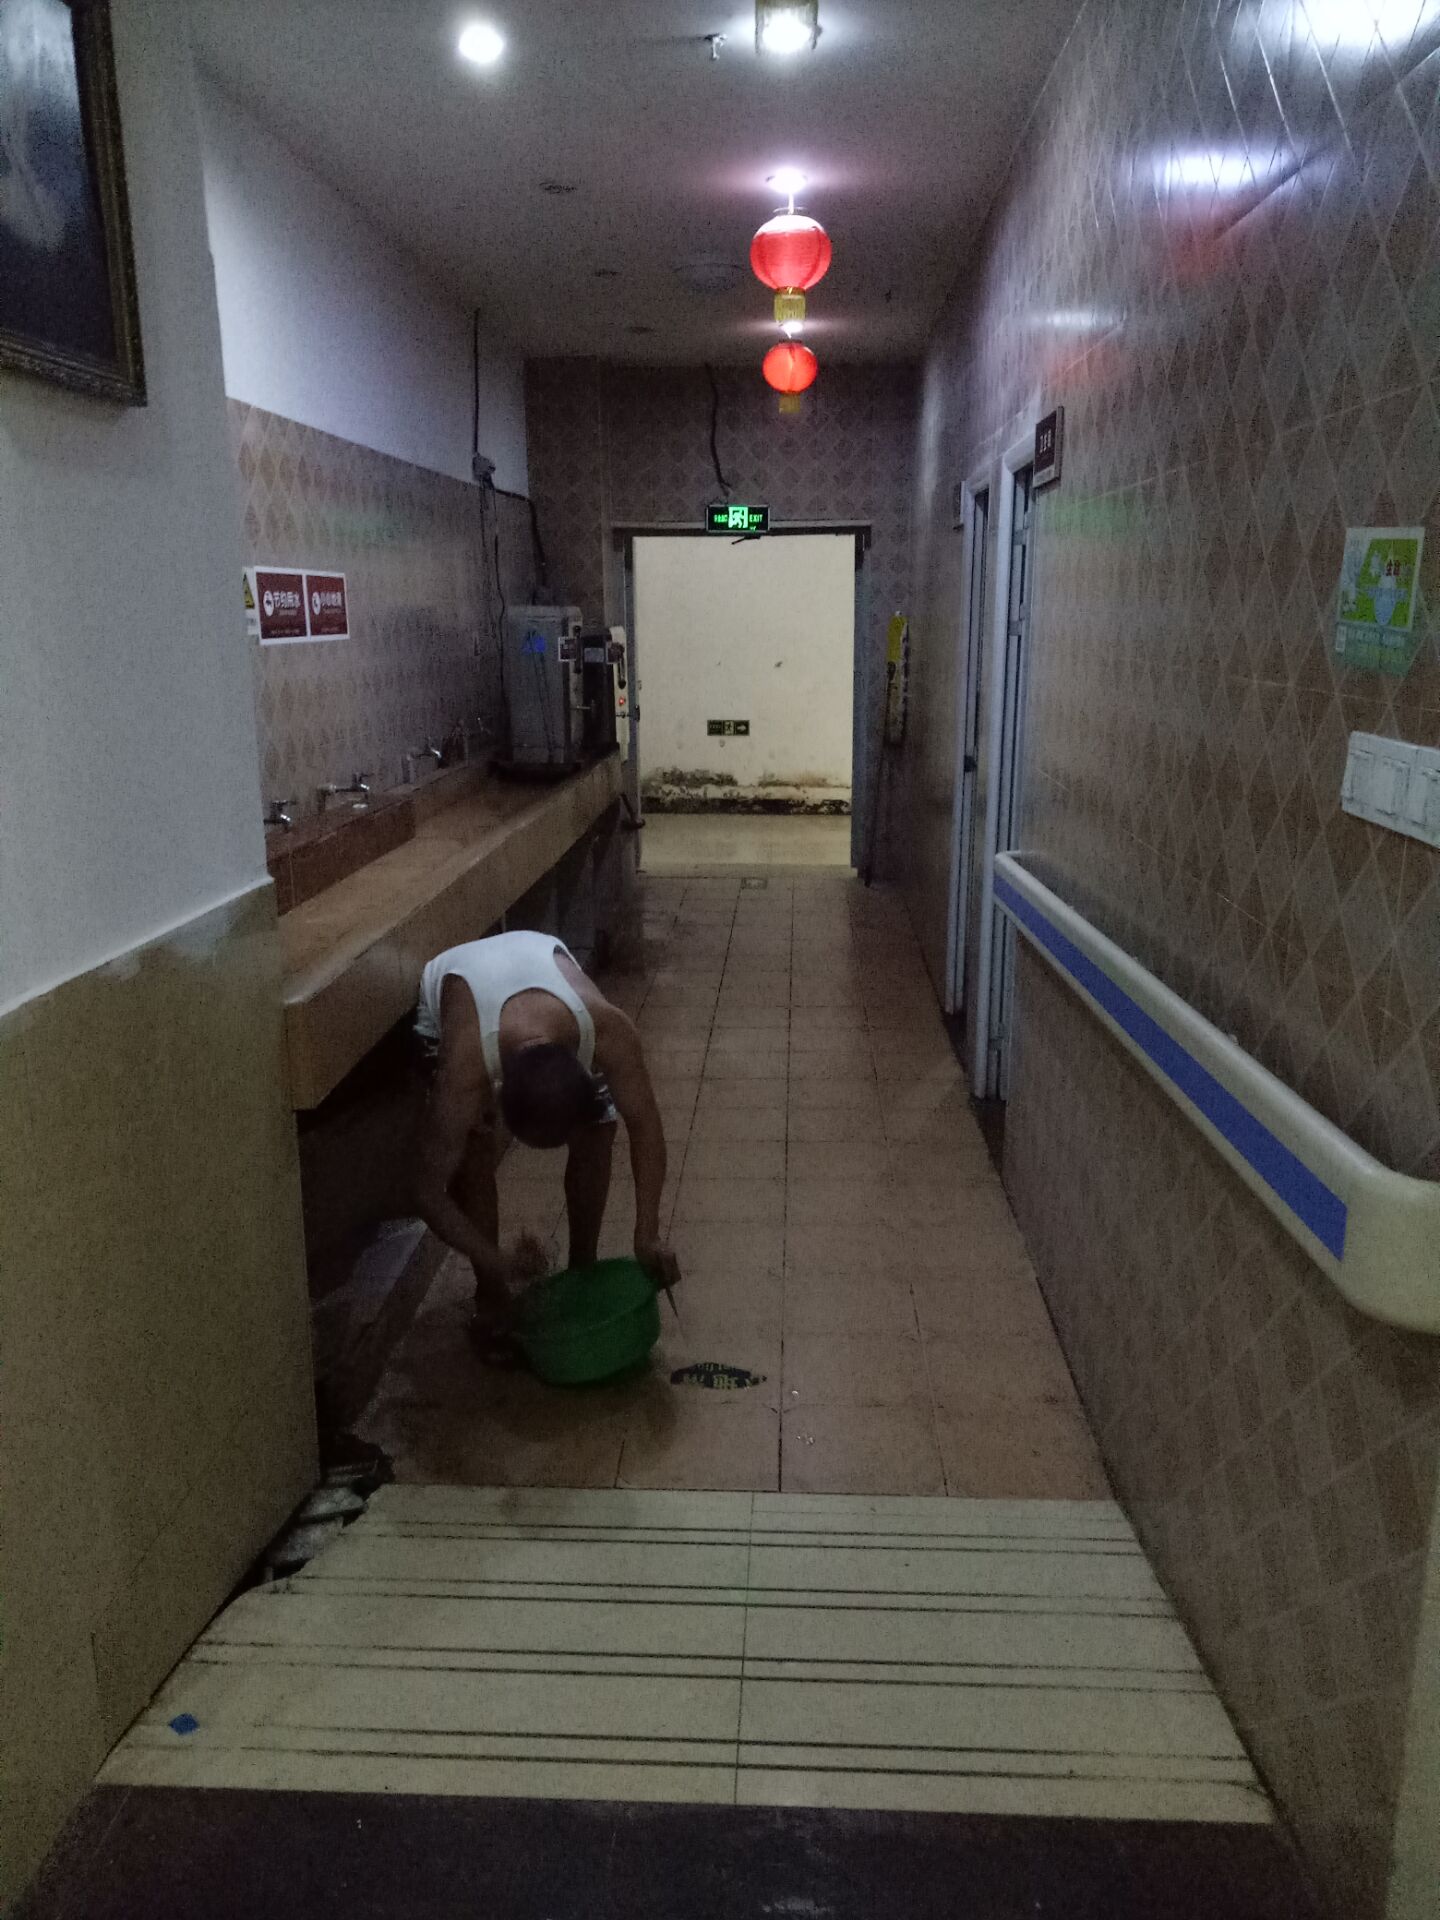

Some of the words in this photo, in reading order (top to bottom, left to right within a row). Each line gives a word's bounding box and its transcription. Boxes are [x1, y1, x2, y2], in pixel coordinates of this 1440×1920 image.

[748, 514, 763, 523] EXIT
[272, 590, 301, 608] 节约用水
